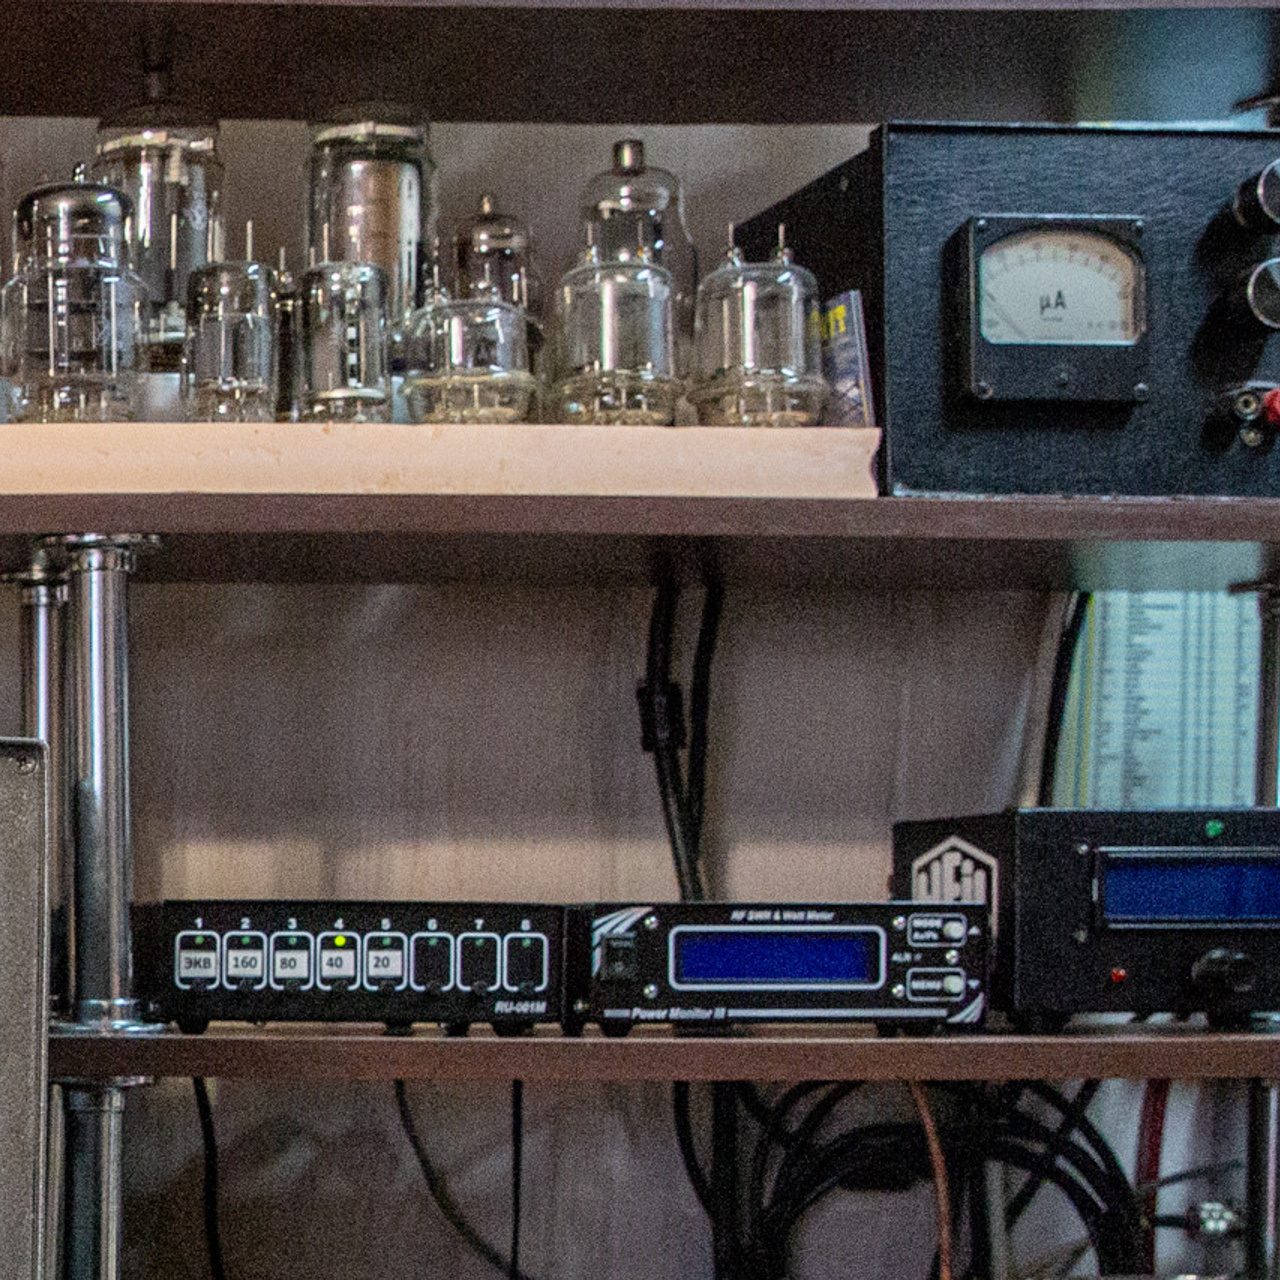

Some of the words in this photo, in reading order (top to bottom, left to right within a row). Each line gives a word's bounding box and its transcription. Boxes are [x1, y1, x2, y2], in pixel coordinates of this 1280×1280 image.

[194, 917, 203, 929] 1
[240, 918, 251, 929] 2
[287, 918, 297, 930] 3
[334, 918, 344, 929] 4
[184, 957, 211, 969] ЭКВ
[233, 956, 257, 968] 160
[280, 957, 297, 969] 80
[326, 956, 343, 968] 40
[373, 956, 390, 968] 20
